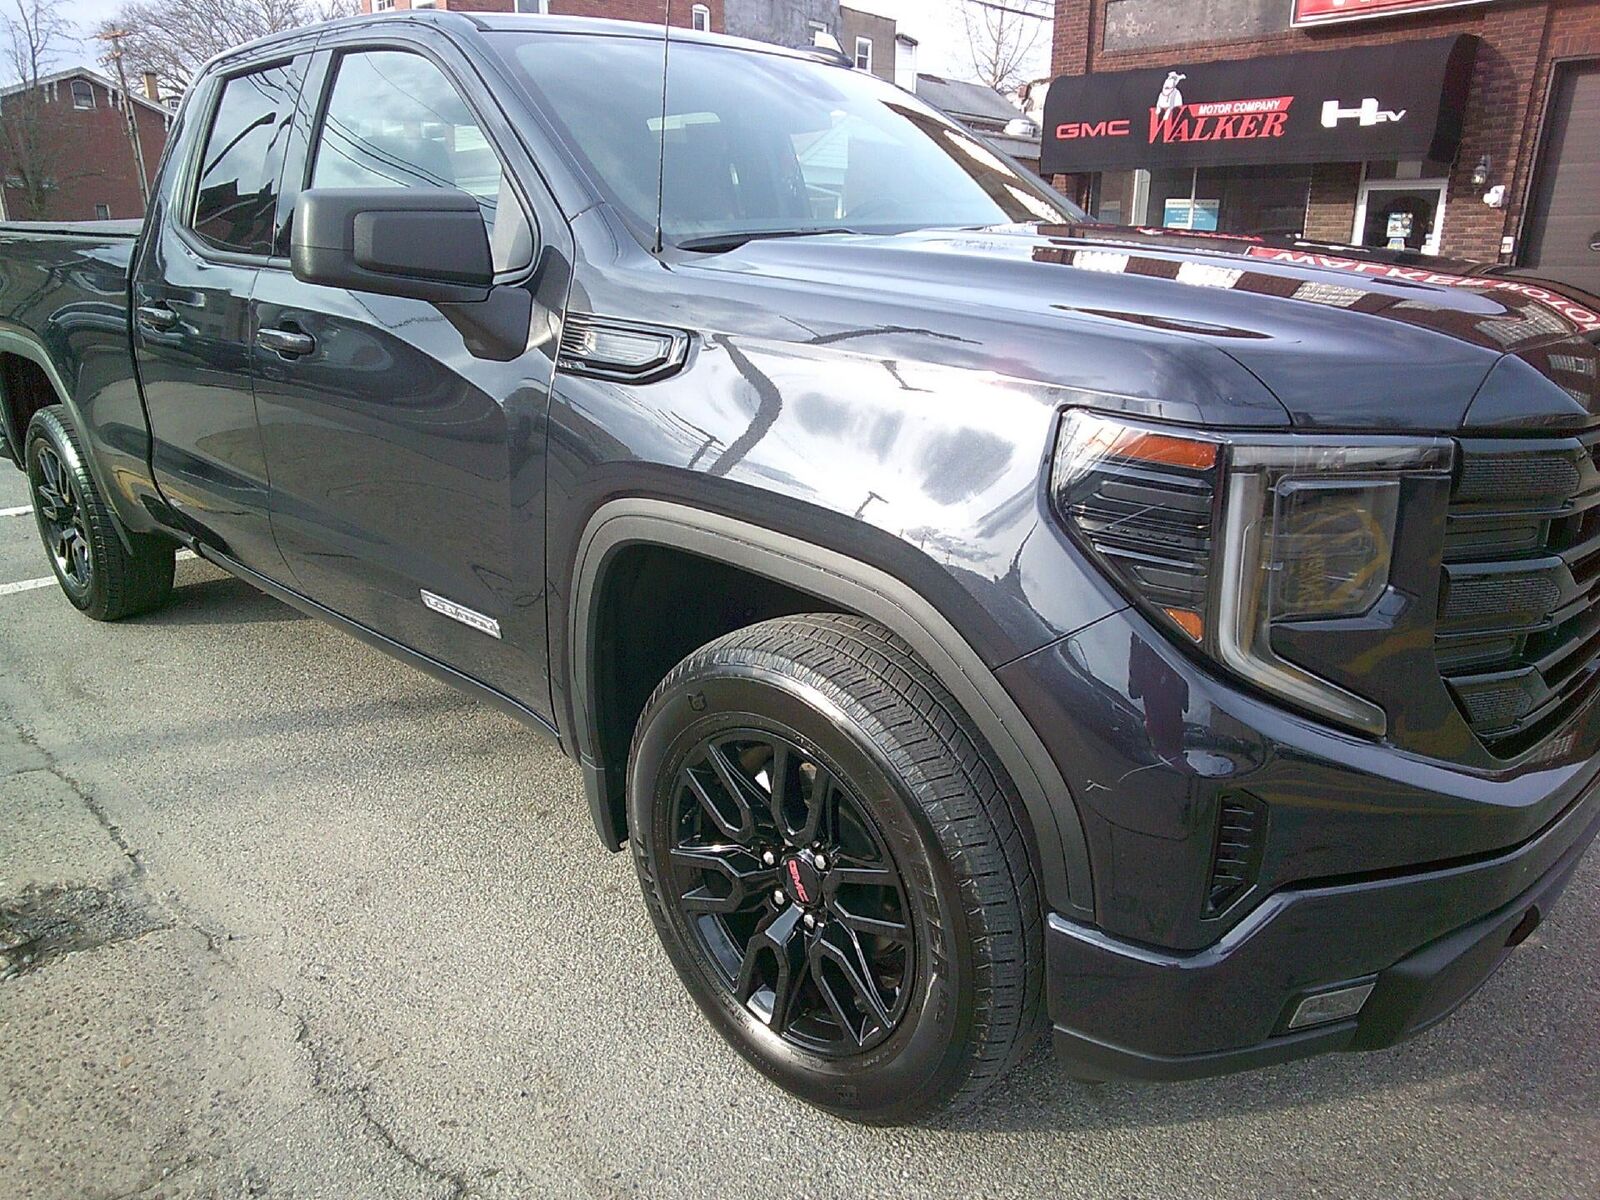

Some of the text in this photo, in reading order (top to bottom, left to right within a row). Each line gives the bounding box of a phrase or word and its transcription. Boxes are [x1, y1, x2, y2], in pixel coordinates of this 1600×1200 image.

[1198, 100, 1280, 115] MOTOR COMPANY
[1056, 120, 1130, 139] GMC
[1149, 104, 1288, 144] WALKER
[788, 859, 810, 903] GMC
